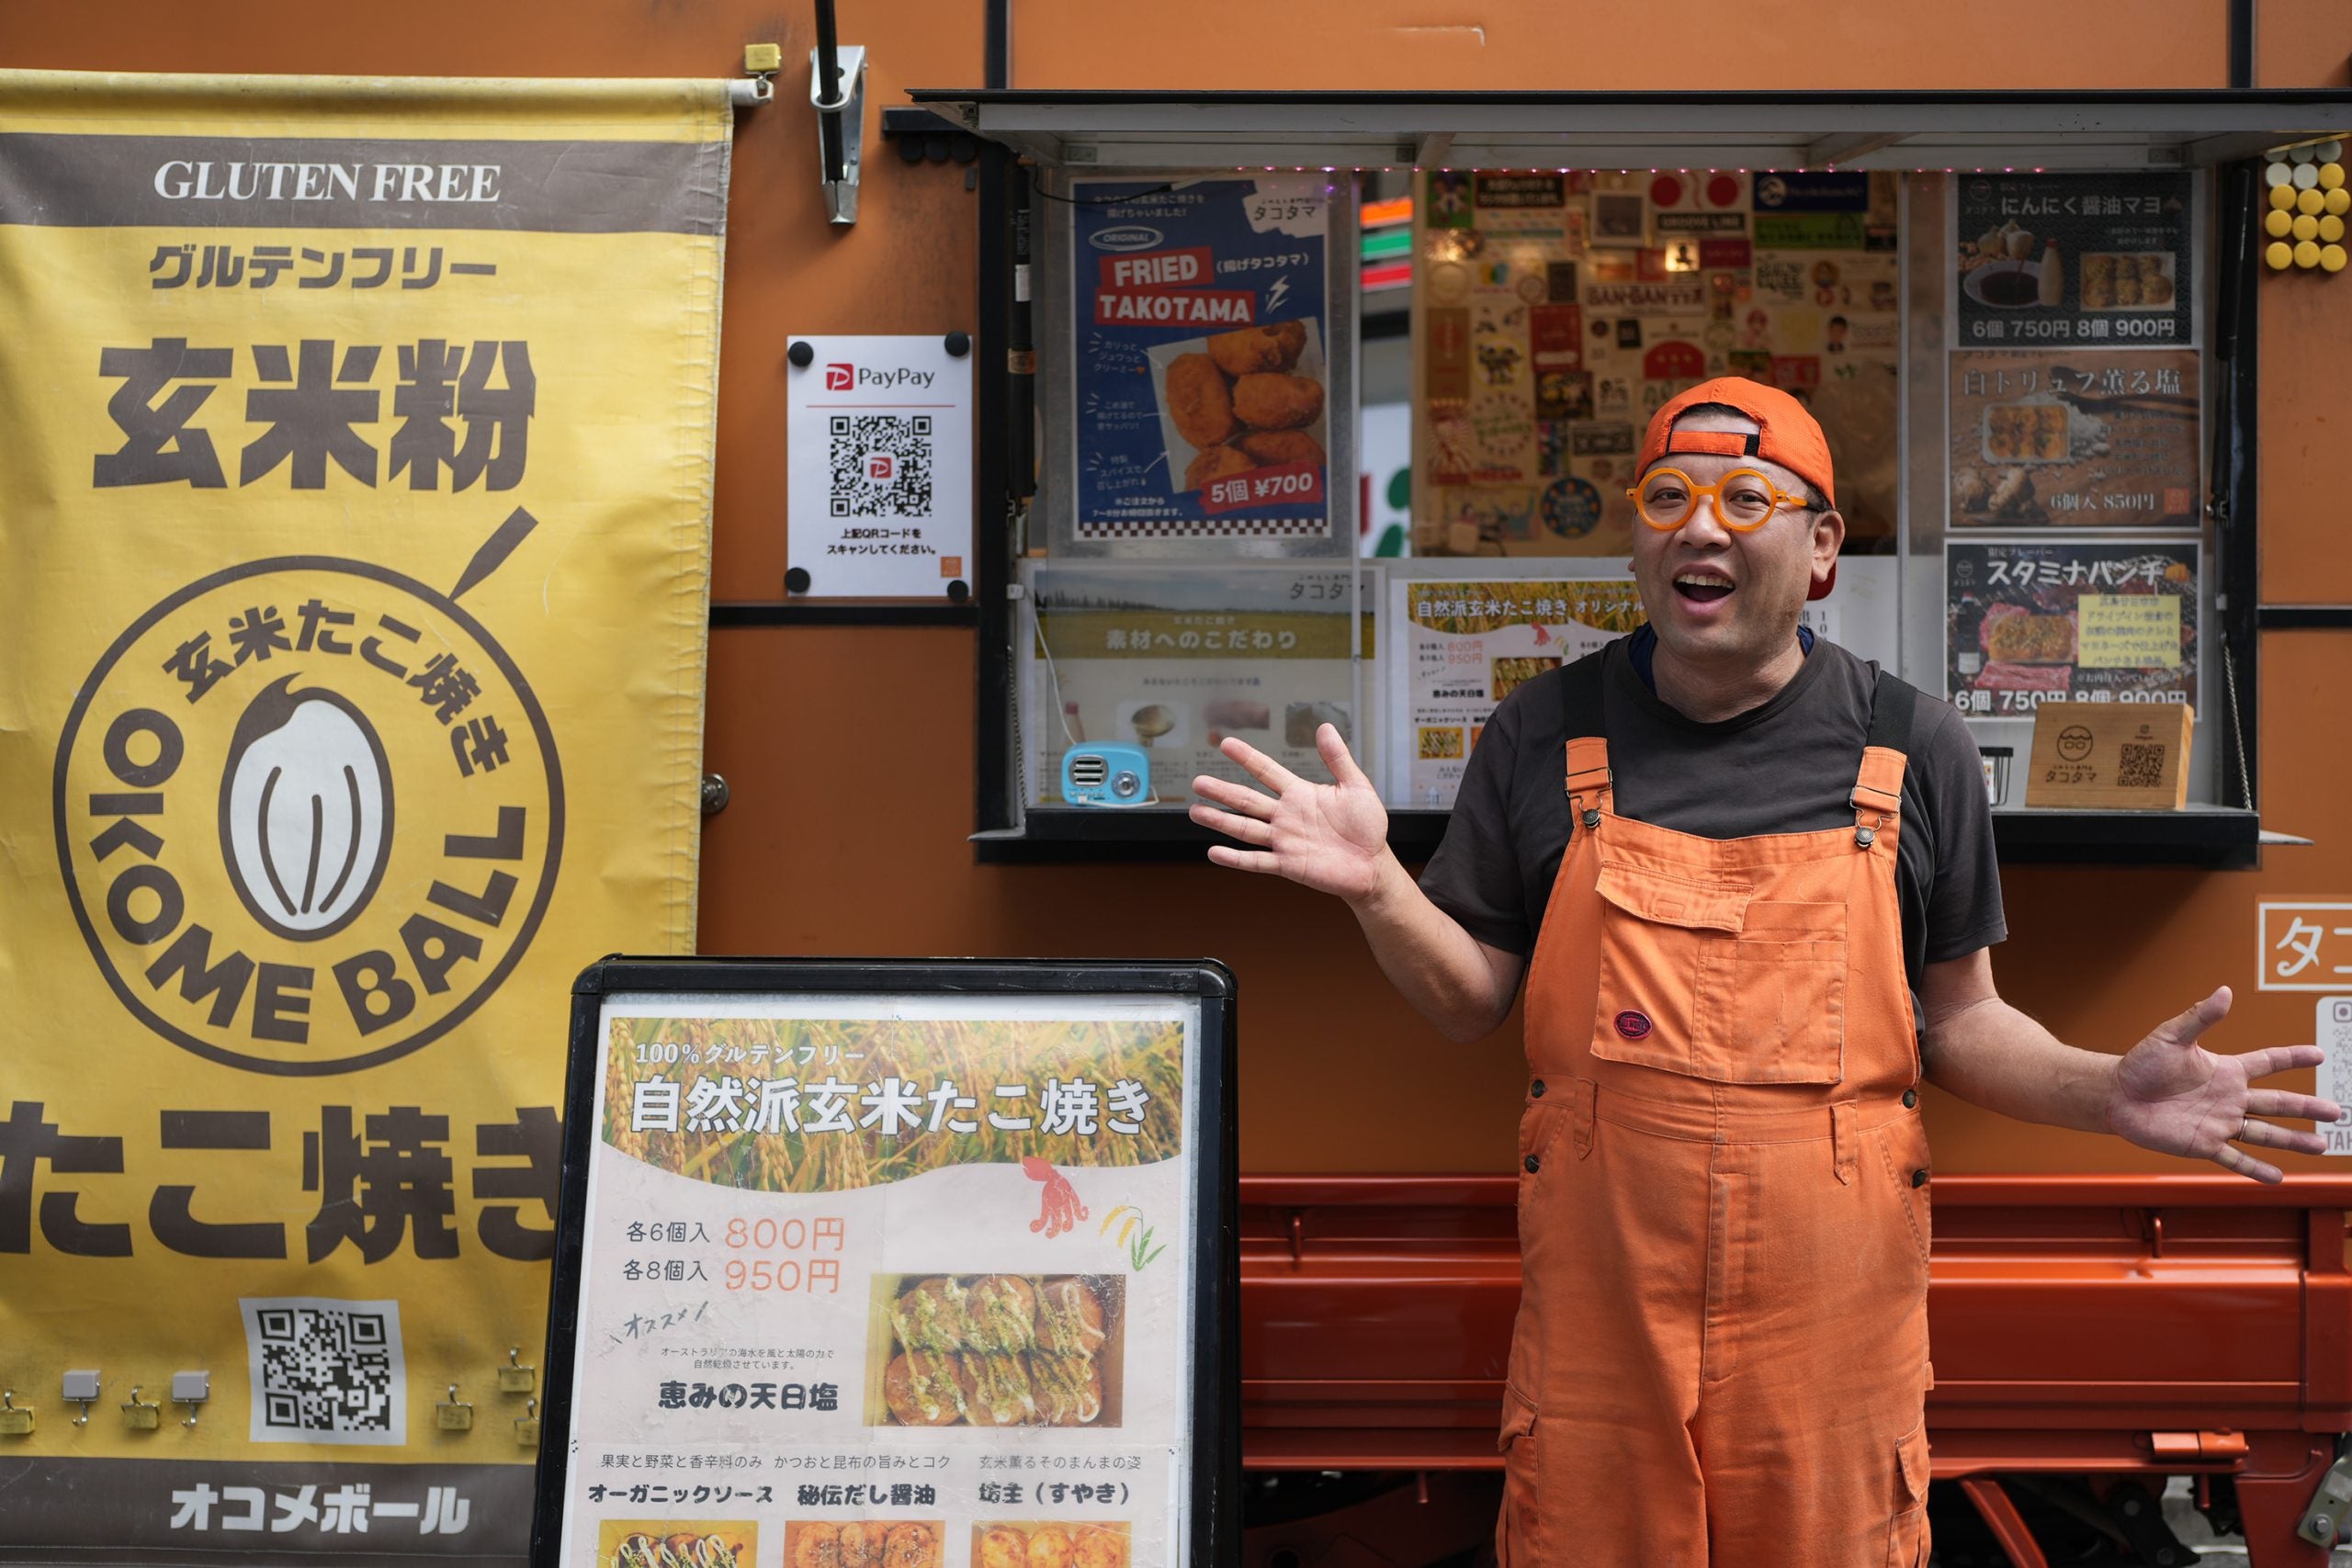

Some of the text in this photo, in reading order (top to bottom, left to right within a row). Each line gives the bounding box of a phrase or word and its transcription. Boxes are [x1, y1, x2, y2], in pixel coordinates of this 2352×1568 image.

[154, 159, 502, 203] GLUTEN FREE
[1254, 205, 1317, 221] タコタマ
[2001, 196, 2161, 217] にんにく醤油マヨ
[1102, 232, 1150, 243] ORIGINAL
[150, 244, 497, 289] グルテンフリー
[1114, 254, 1199, 288] FRIED
[1100, 294, 1251, 322] TAKOTAMA
[1973, 320, 2176, 339] 6個 750円 8個 900円
[859, 367, 935, 389] PayPay
[1963, 368, 2182, 397] 白トリュフ薫る塩
[93, 337, 537, 494] 玄米粉
[1211, 472, 1313, 504] 5個 ¥700
[841, 528, 922, 539] 上記QRコードを
[827, 544, 936, 555] スキャンしてください。
[1986, 559, 2165, 586] スタミナパンチ
[1417, 599, 1567, 618] 自然派玄米たこ焼き
[1105, 629, 1297, 650] 素材へのこだわり
[1447, 641, 1484, 652] 800円
[1447, 653, 1483, 664] 950円
[162, 598, 510, 778] 玄米たこ焼き
[1954, 691, 1992, 712] 6個
[2045, 770, 2098, 784] タコタマ
[89, 707, 527, 1044] OKOME BALL
[634, 1042, 865, 1068] 100%グルテンフリー
[630, 1075, 1150, 1136] 自然派玄米たこ焼き
[626, 1217, 845, 1252] 各6個入 800円
[622, 1258, 841, 1293] 各8個入 950円
[658, 1381, 839, 1413] 恵みの天日塩
[601, 1453, 763, 1471] 果実と野菜と香辛料のみ
[774, 1453, 951, 1471] かつおと昆布の旨みとコク
[978, 1453, 1142, 1472] 玄米薫るそのまんまの姿
[587, 1483, 775, 1504] オーガニックソース
[797, 1483, 936, 1507] 秘伝だし醤油
[170, 1483, 470, 1534] オコメボール
